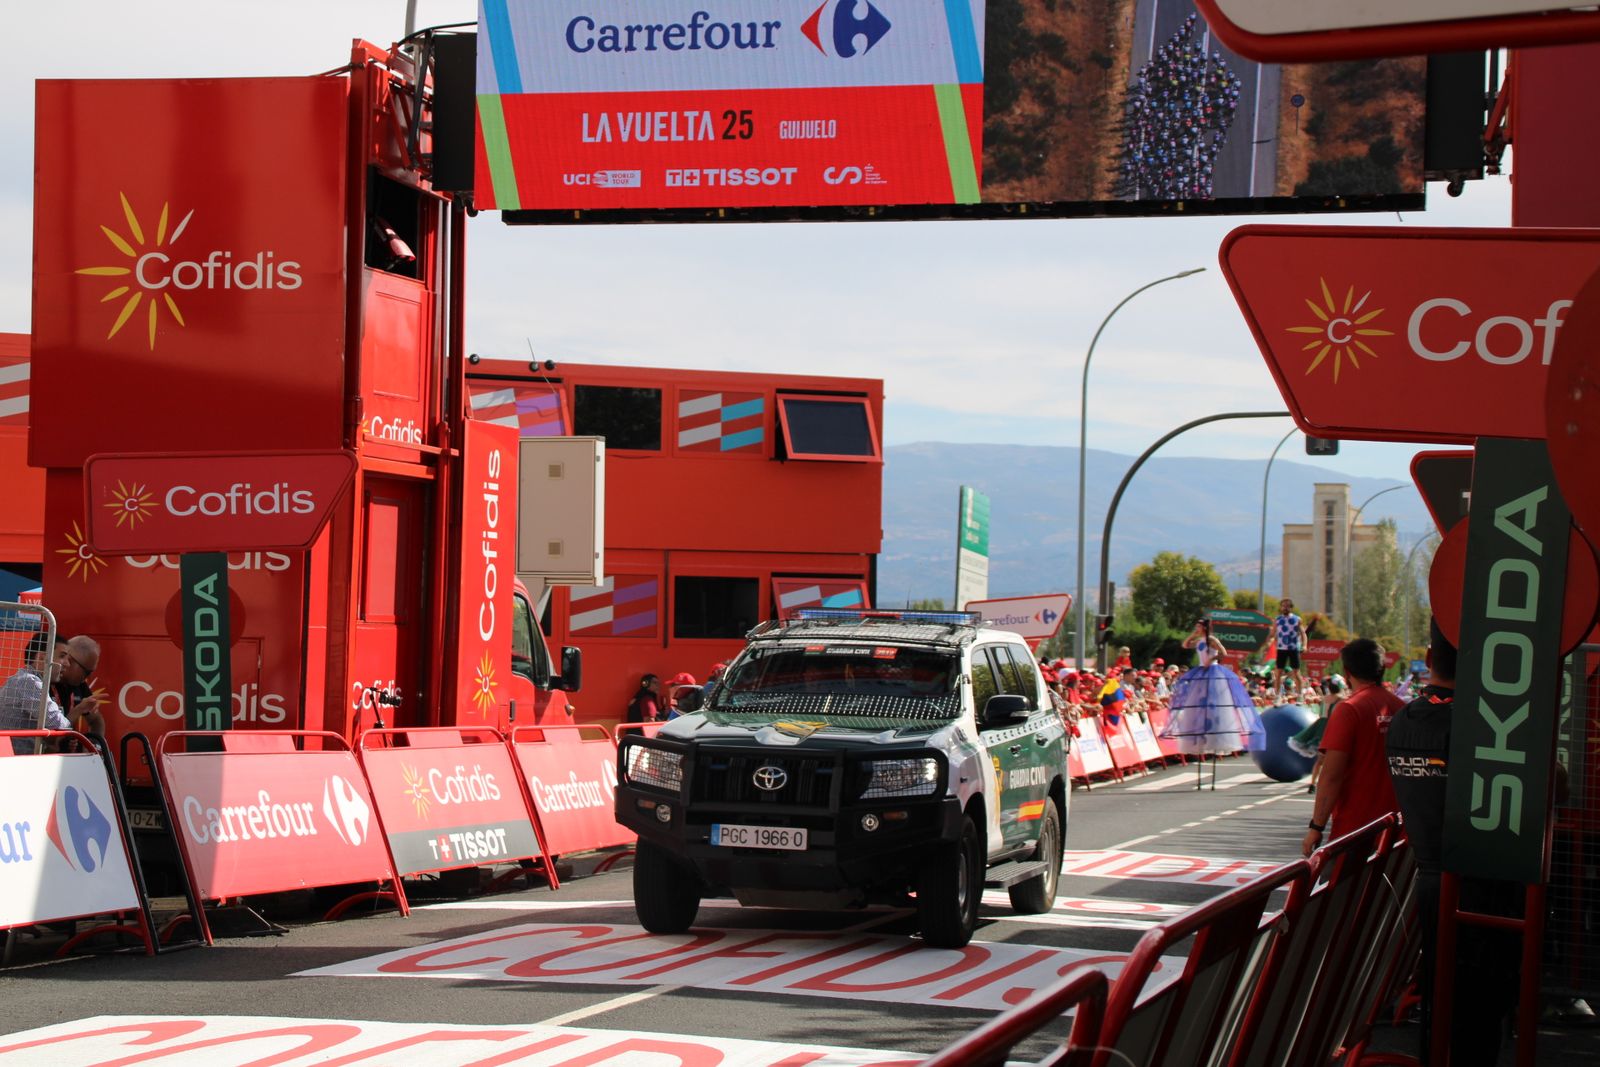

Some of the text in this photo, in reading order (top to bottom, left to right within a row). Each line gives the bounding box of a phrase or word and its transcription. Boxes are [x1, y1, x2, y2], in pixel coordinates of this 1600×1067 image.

[565, 12, 781, 53] Carrefour
[582, 110, 754, 142] LA VUELTA 25
[779, 120, 836, 139] GUIJUELO
[563, 174, 590, 185] UCI
[704, 168, 797, 186] TISSOT
[135, 251, 302, 290] Cofidis
[165, 482, 315, 516] Cofidis
[479, 449, 500, 641] Cofidis
[118, 680, 286, 723] Codis
[429, 764, 501, 805] Cofidis
[531, 770, 604, 813] Carrefour
[183, 790, 317, 845] Carrefour
[450, 828, 507, 860] TISSOT
[721, 827, 748, 844] PGC
[754, 830, 789, 846] 1966
